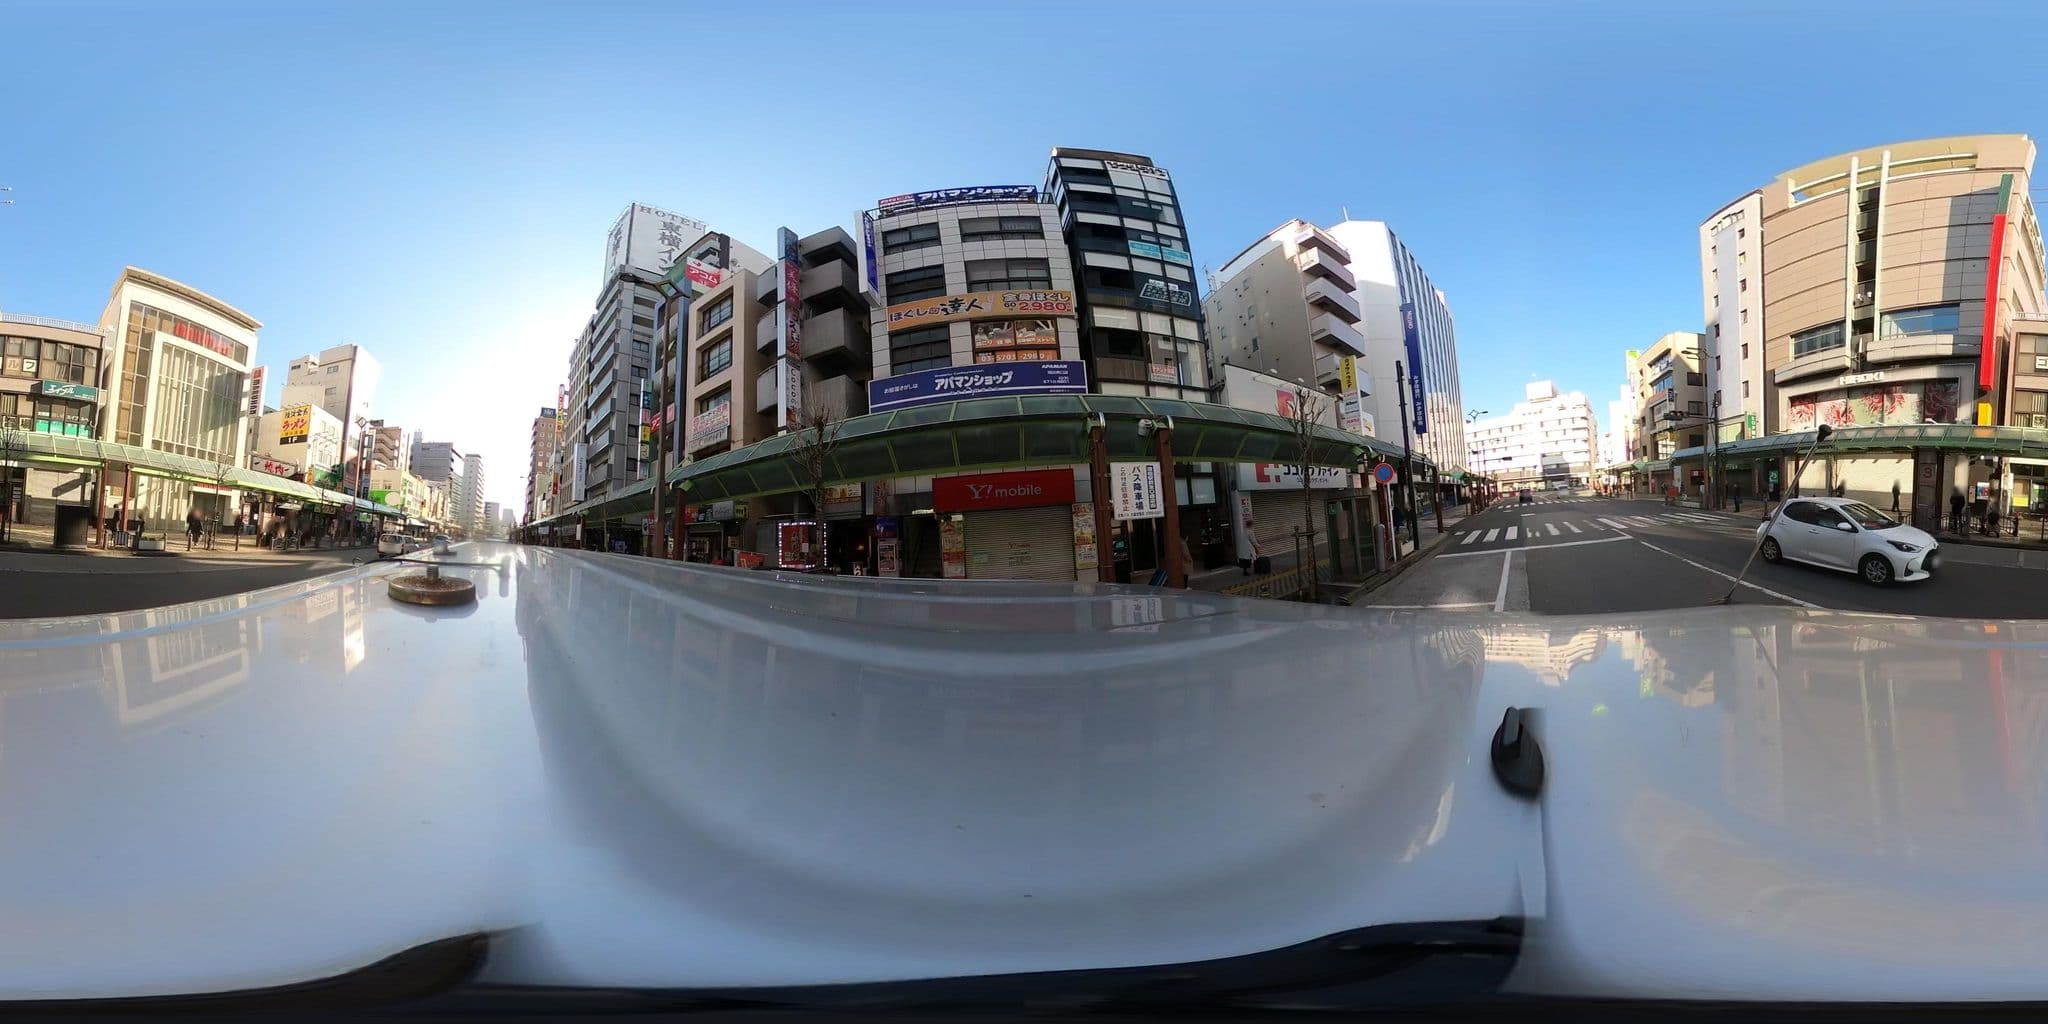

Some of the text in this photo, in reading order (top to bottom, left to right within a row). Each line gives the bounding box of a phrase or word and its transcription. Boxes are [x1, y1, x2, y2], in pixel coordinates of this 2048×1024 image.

[917, 186, 1034, 201] アパマンショップ
[639, 205, 703, 236] HOTEL
[657, 221, 682, 272] 東横イン
[689, 266, 718, 284] アコム
[934, 370, 1014, 390] アパマンショップ
[1132, 465, 1144, 510] バス降車場
